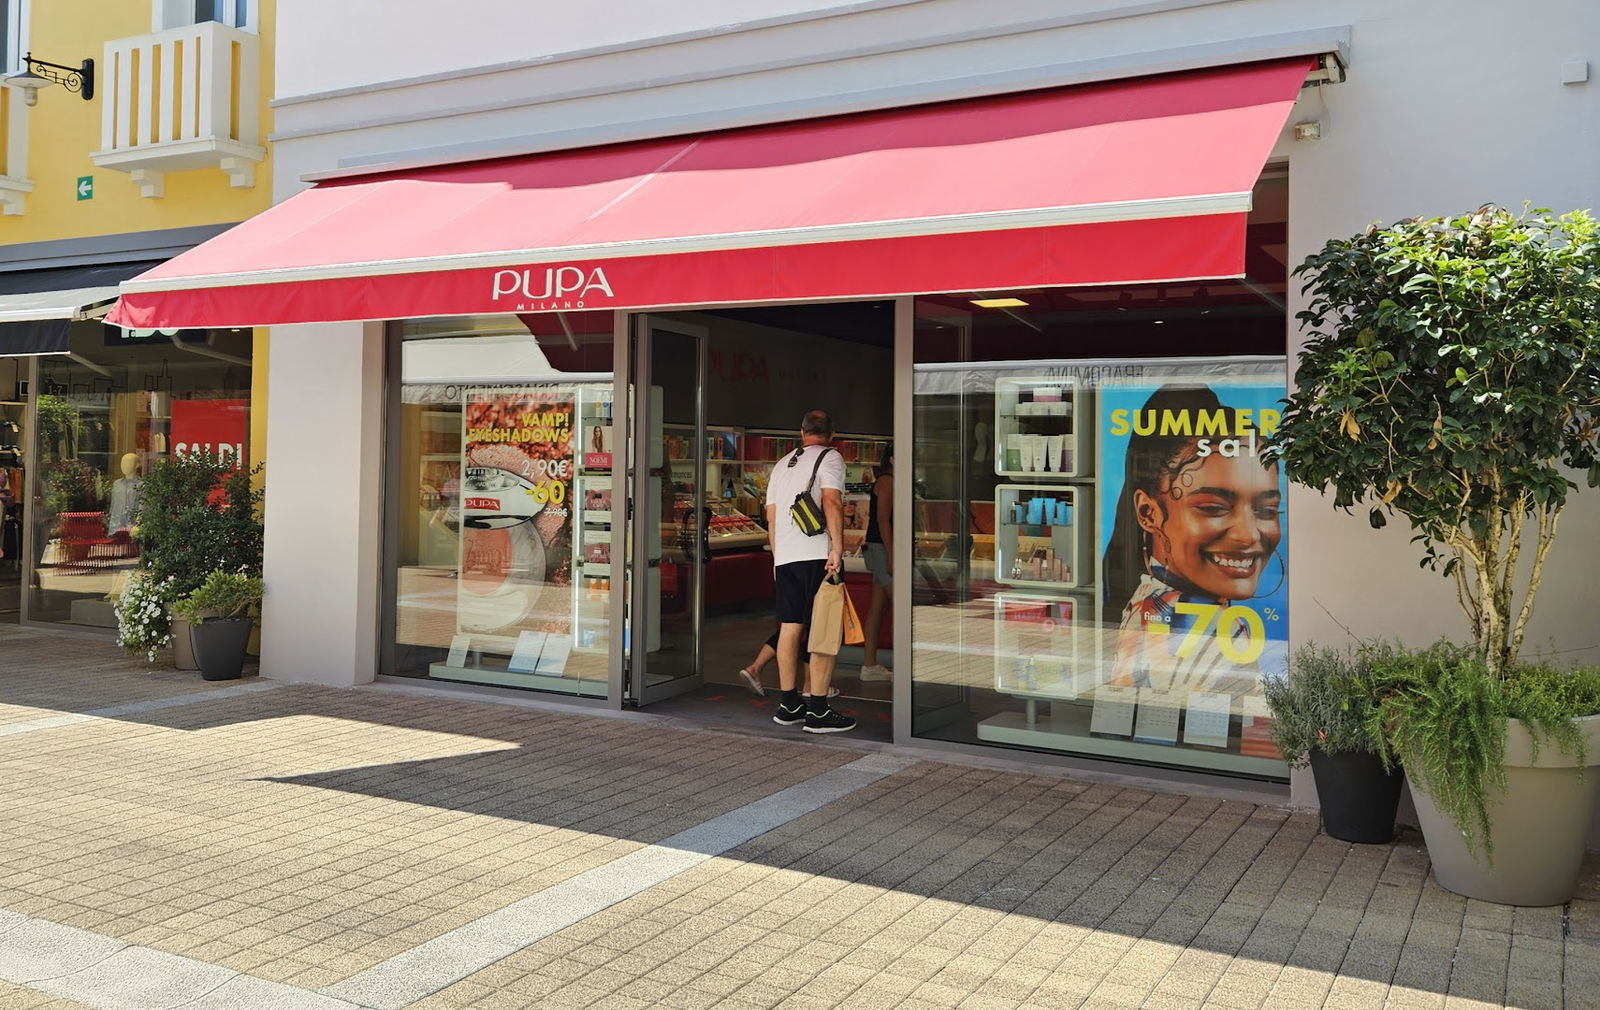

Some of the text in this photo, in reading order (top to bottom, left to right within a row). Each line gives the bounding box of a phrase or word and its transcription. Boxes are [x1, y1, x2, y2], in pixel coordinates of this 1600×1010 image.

[492, 266, 614, 300] PUPA
[516, 300, 585, 311] MILANO
[521, 412, 569, 427] VAMP!
[1110, 408, 1281, 436] SUMMER
[468, 428, 569, 443] EYESHADOWS
[175, 442, 242, 471] SALDI
[521, 459, 568, 479] 2,90€
[464, 499, 500, 509] PUPA
[1144, 611, 1162, 623] fino
